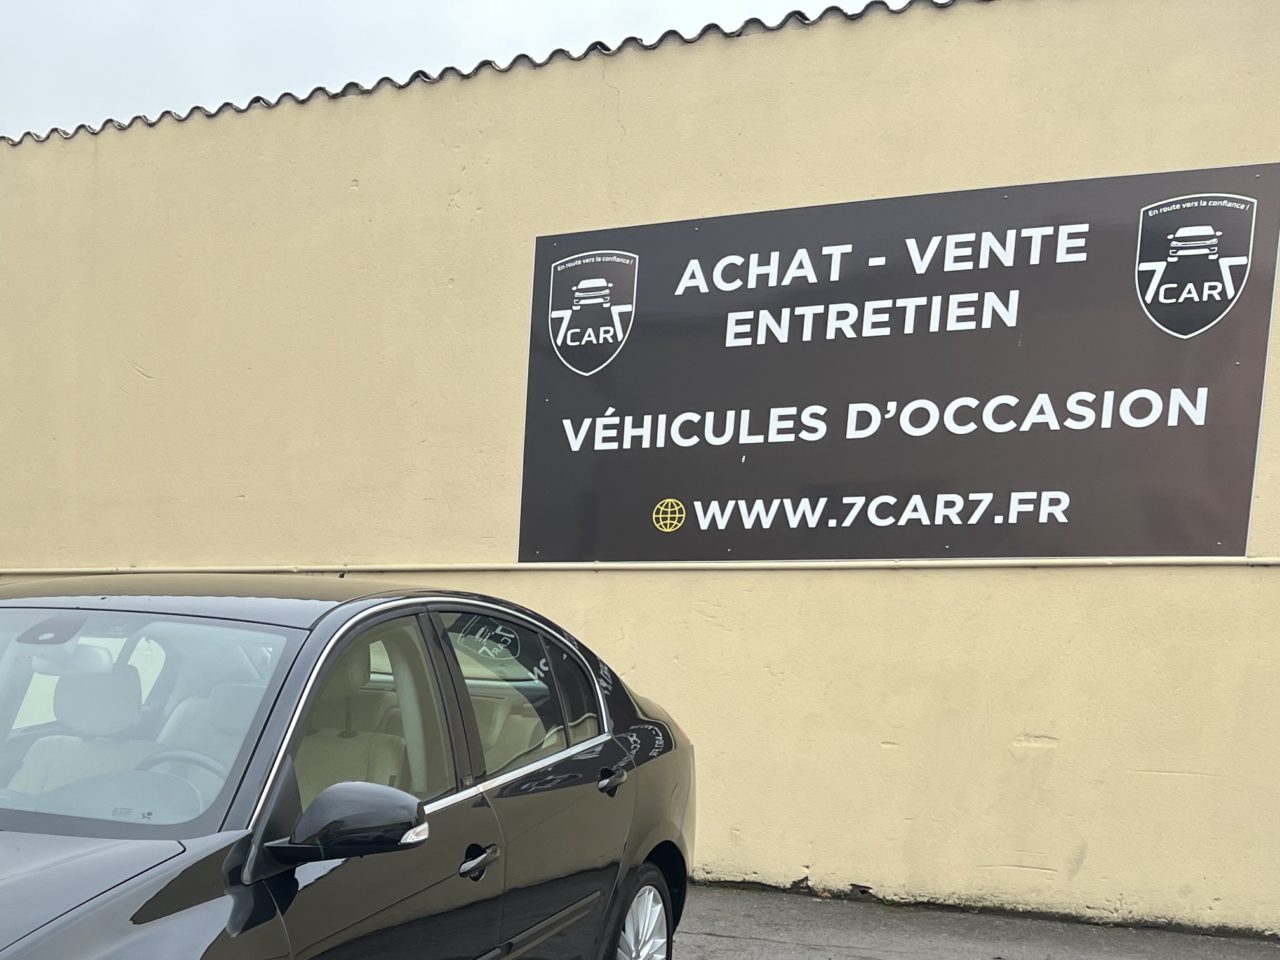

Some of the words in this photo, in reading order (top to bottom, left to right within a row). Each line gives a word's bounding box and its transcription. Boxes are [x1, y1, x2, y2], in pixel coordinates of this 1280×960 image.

[1160, 204, 1180, 213] route
[1208, 200, 1245, 211] confiance
[566, 259, 581, 268] route
[602, 255, 629, 264] confiance
[674, 244, 853, 296] ACHAT
[868, 256, 886, 267] -
[905, 223, 1090, 275] VENTE
[725, 289, 1020, 348] ENTRETIEN
[562, 404, 828, 452] VÉHICULES
[845, 386, 1210, 440] D'OCCASION
[693, 490, 1071, 530] WWW.7CAR7.FR
